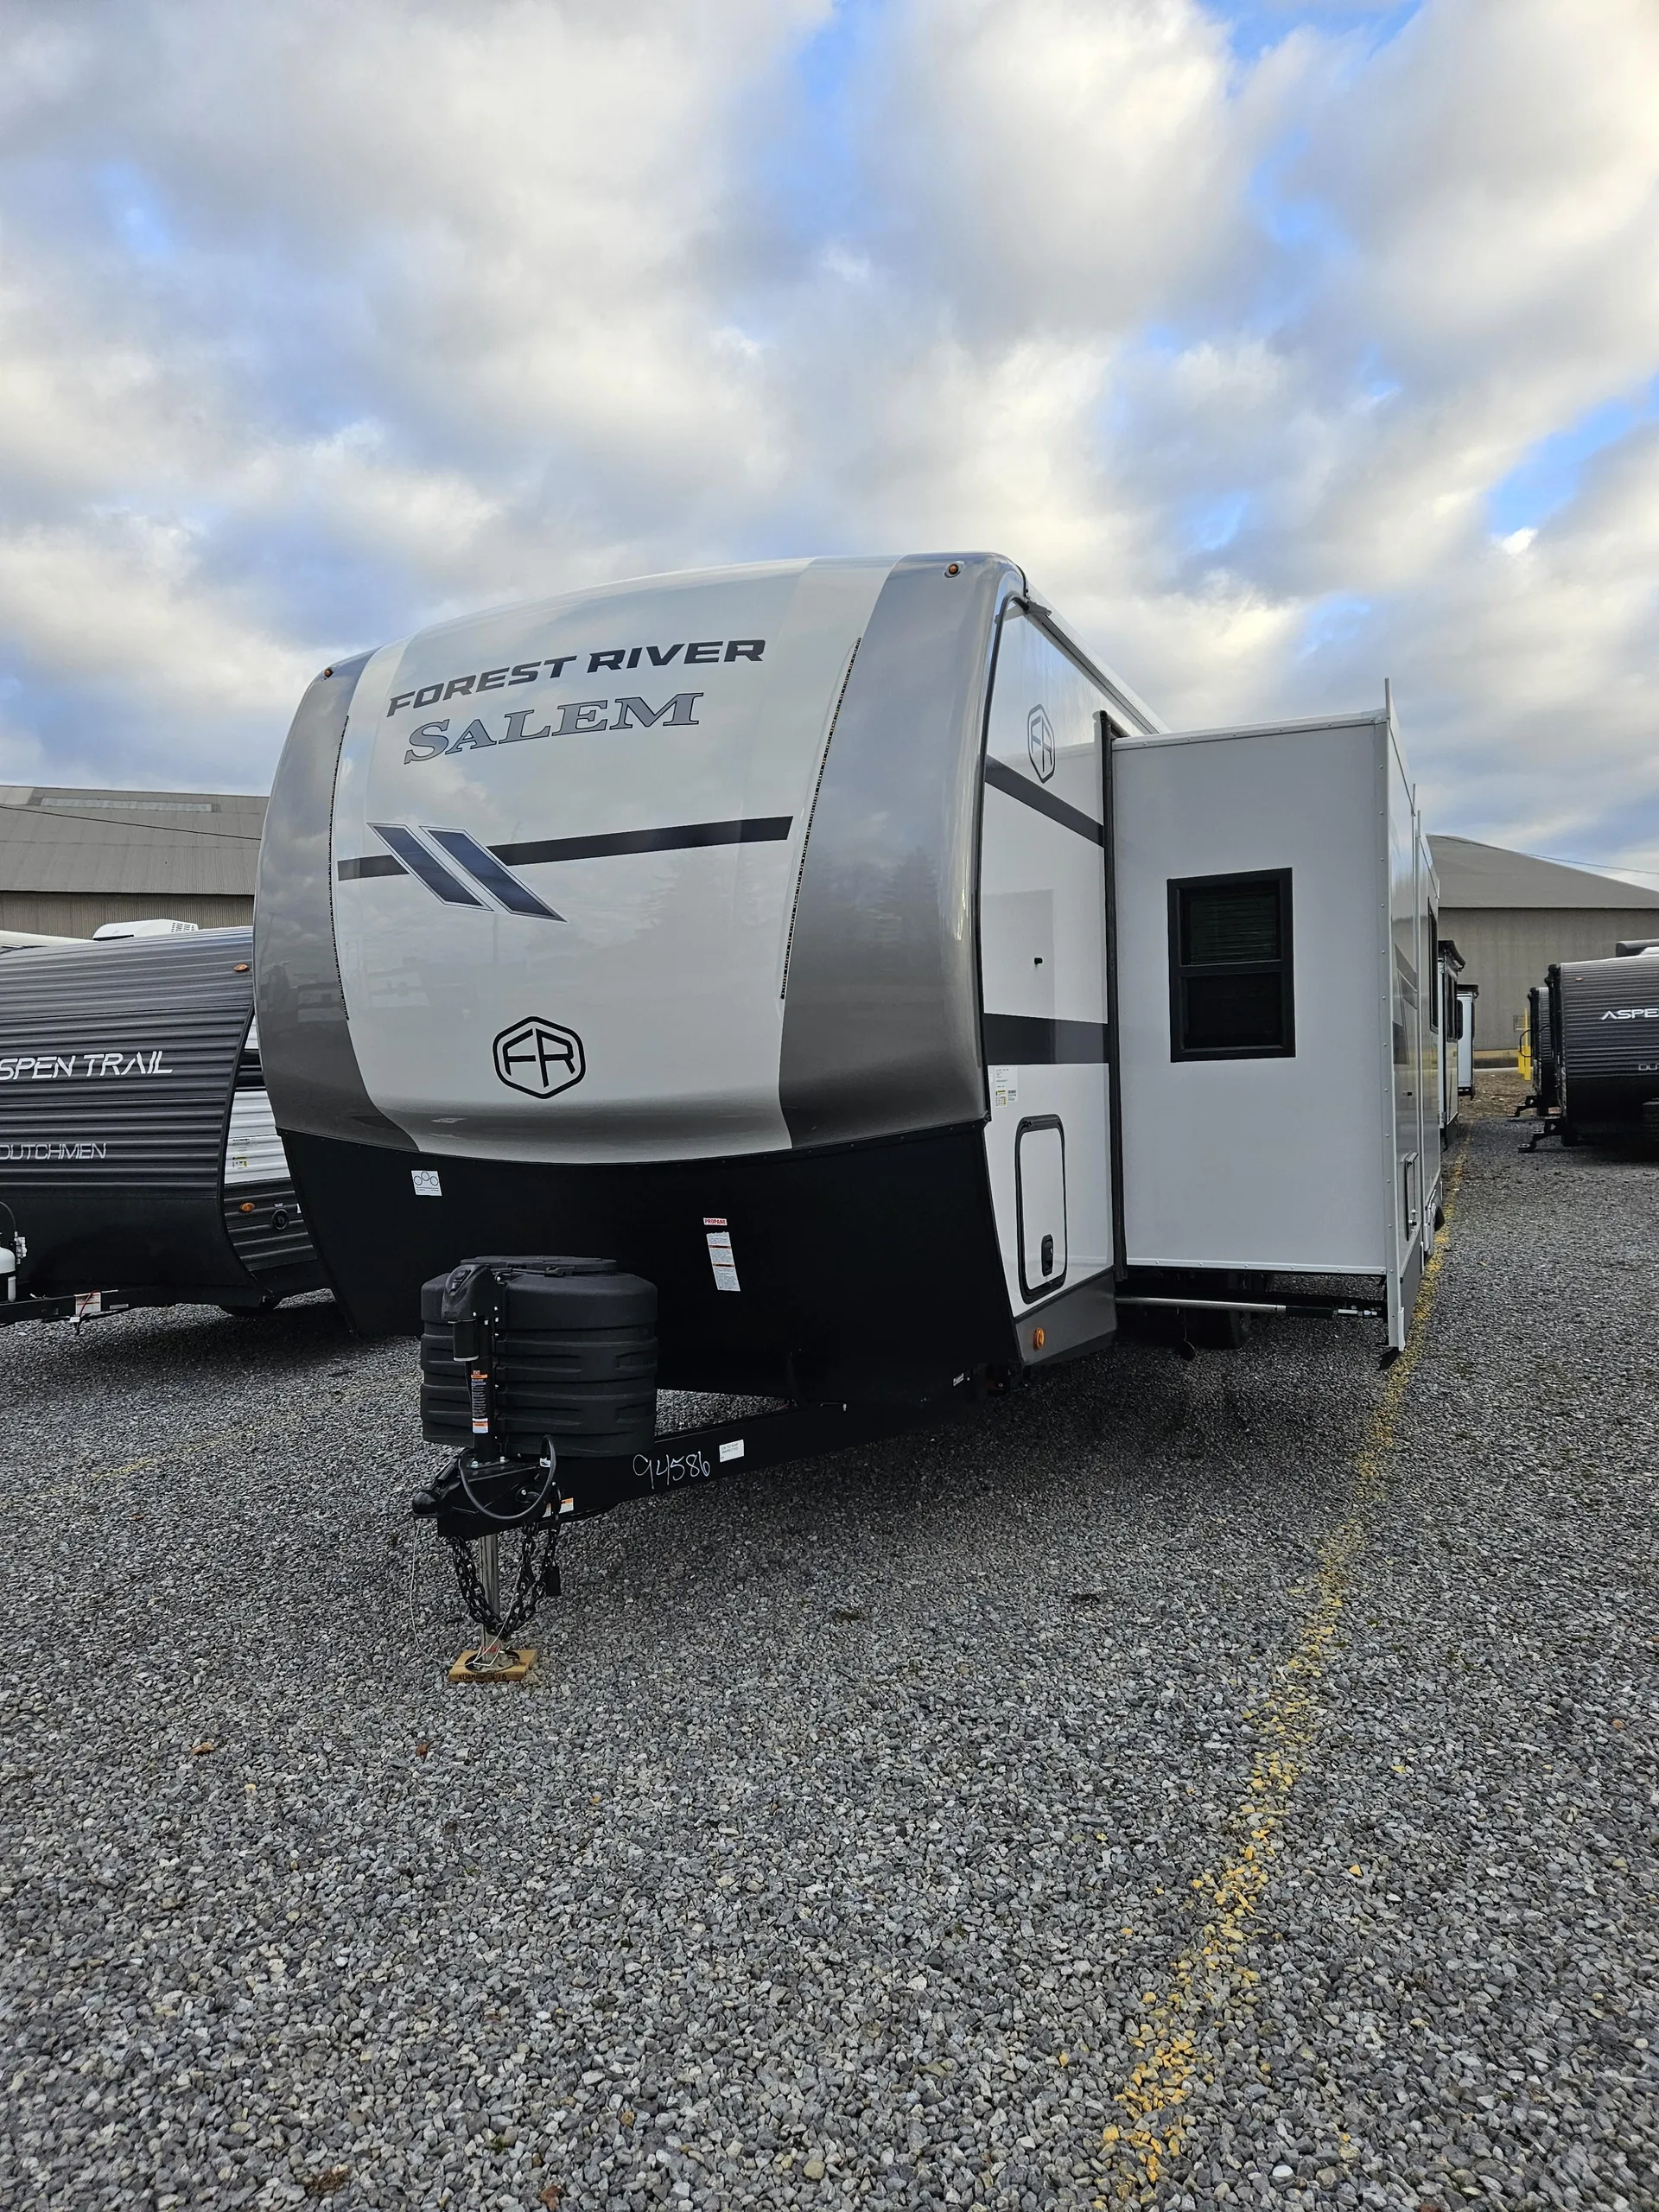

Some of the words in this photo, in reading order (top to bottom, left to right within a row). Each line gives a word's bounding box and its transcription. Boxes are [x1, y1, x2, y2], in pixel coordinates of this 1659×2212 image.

[386, 655, 578, 718] FOREST
[587, 639, 766, 674] RIVER
[404, 692, 704, 764] SALEM
[83, 1051, 173, 1077] TRAIL
[502, 1027, 576, 1088] FR
[632, 1451, 710, 1490] 94586
